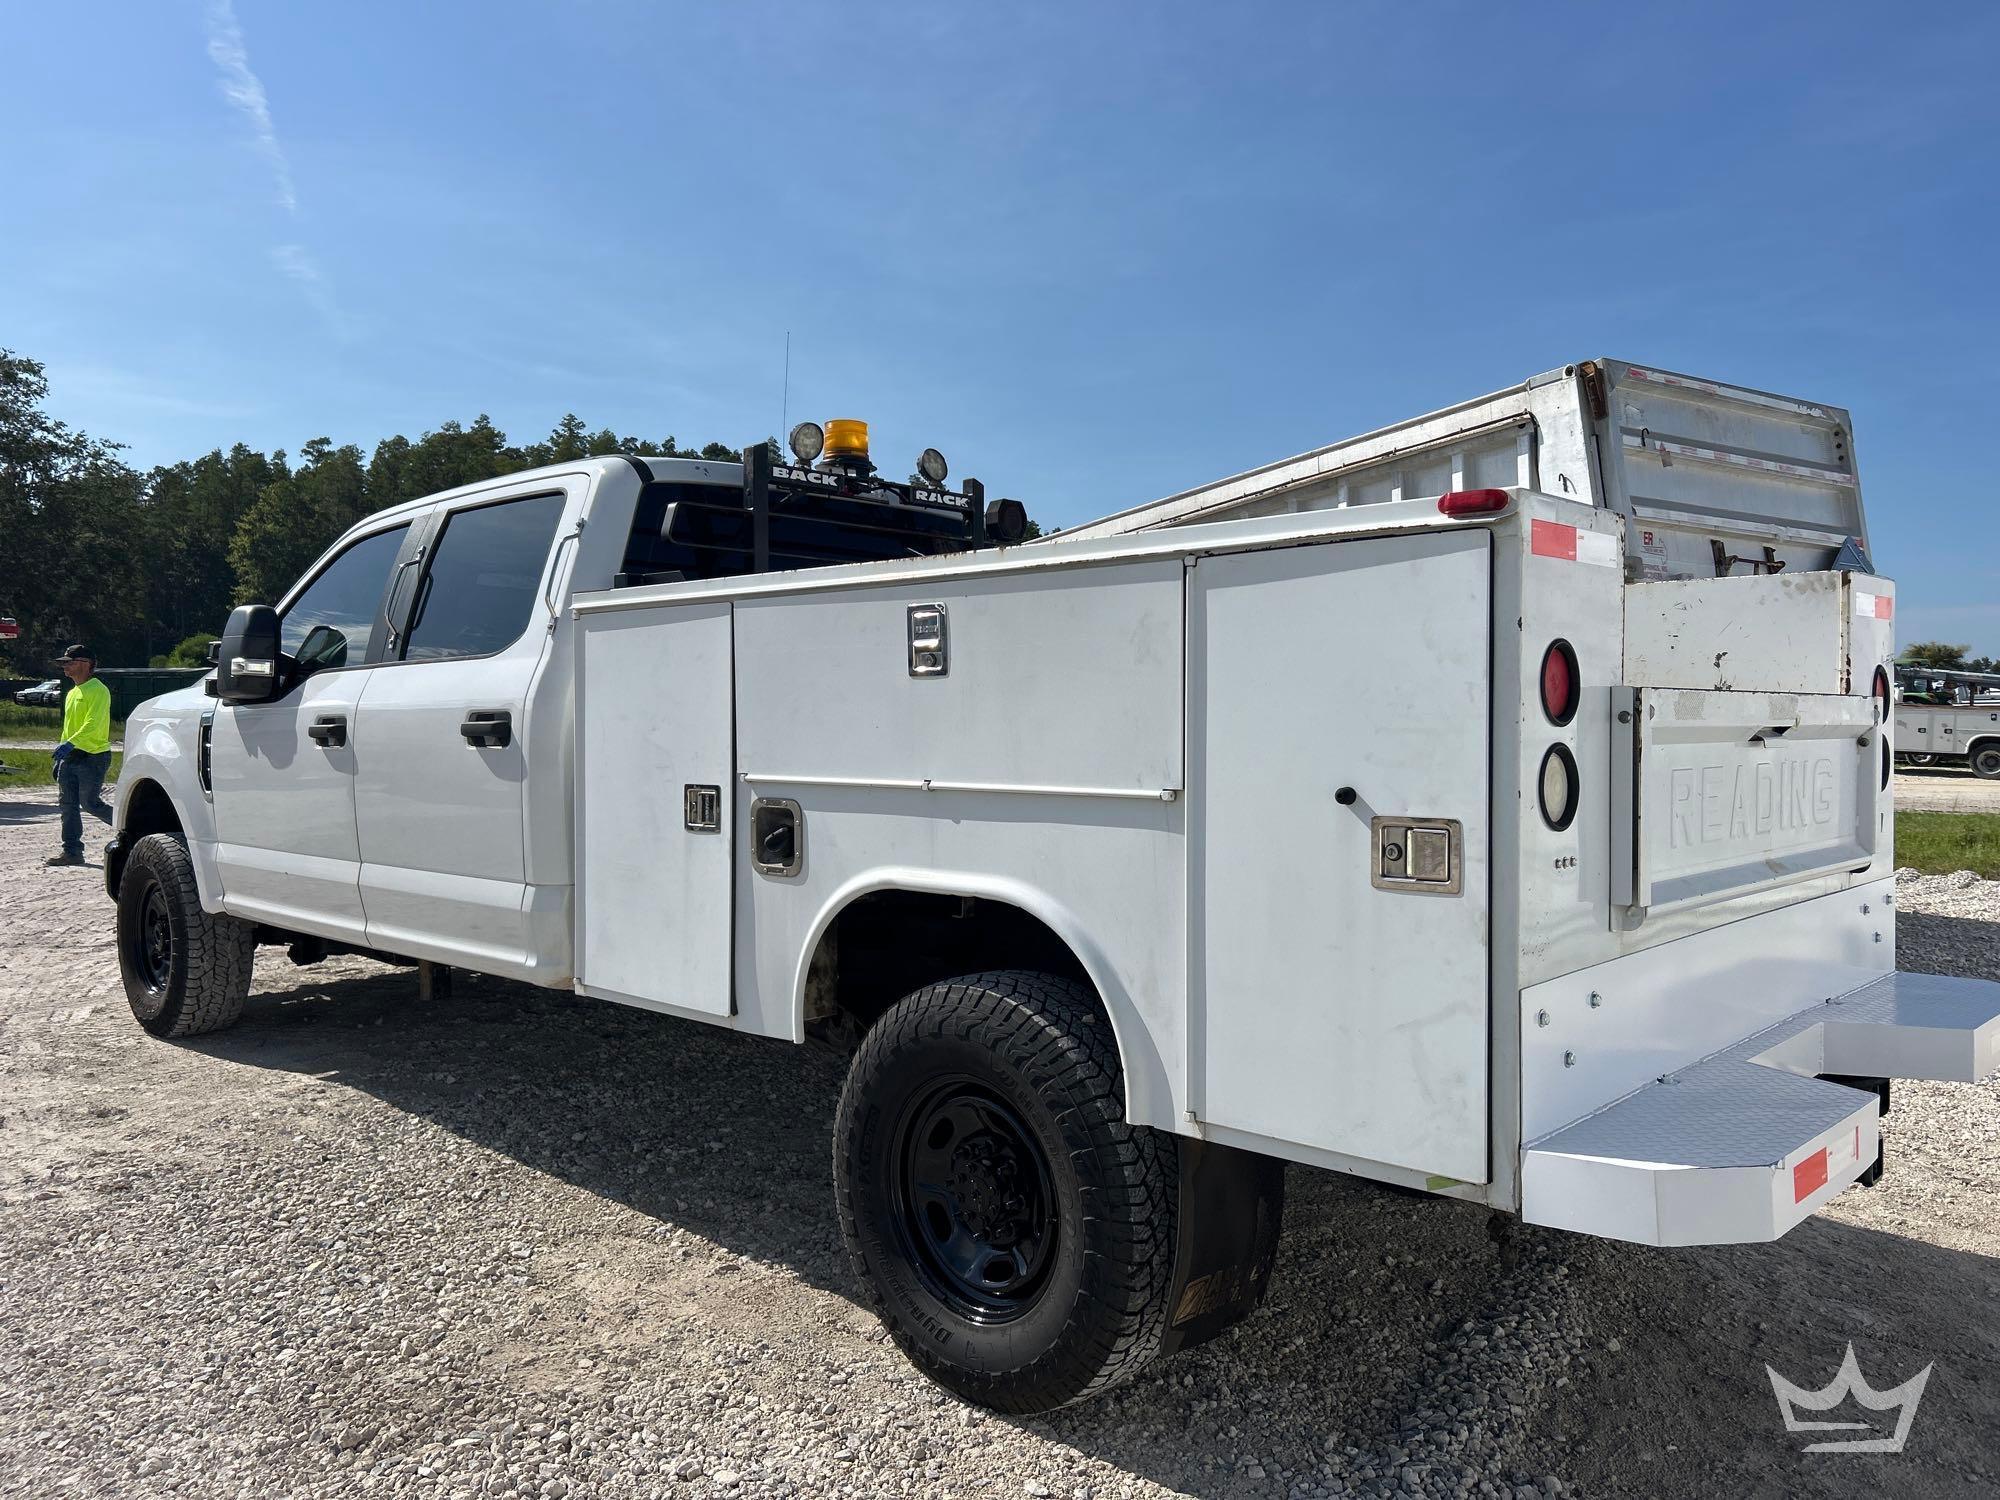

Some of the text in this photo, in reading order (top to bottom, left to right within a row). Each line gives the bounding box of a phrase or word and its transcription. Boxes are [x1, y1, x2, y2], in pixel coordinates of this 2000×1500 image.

[772, 466, 969, 508] BACK RACK
[1670, 758, 1833, 849] READING
